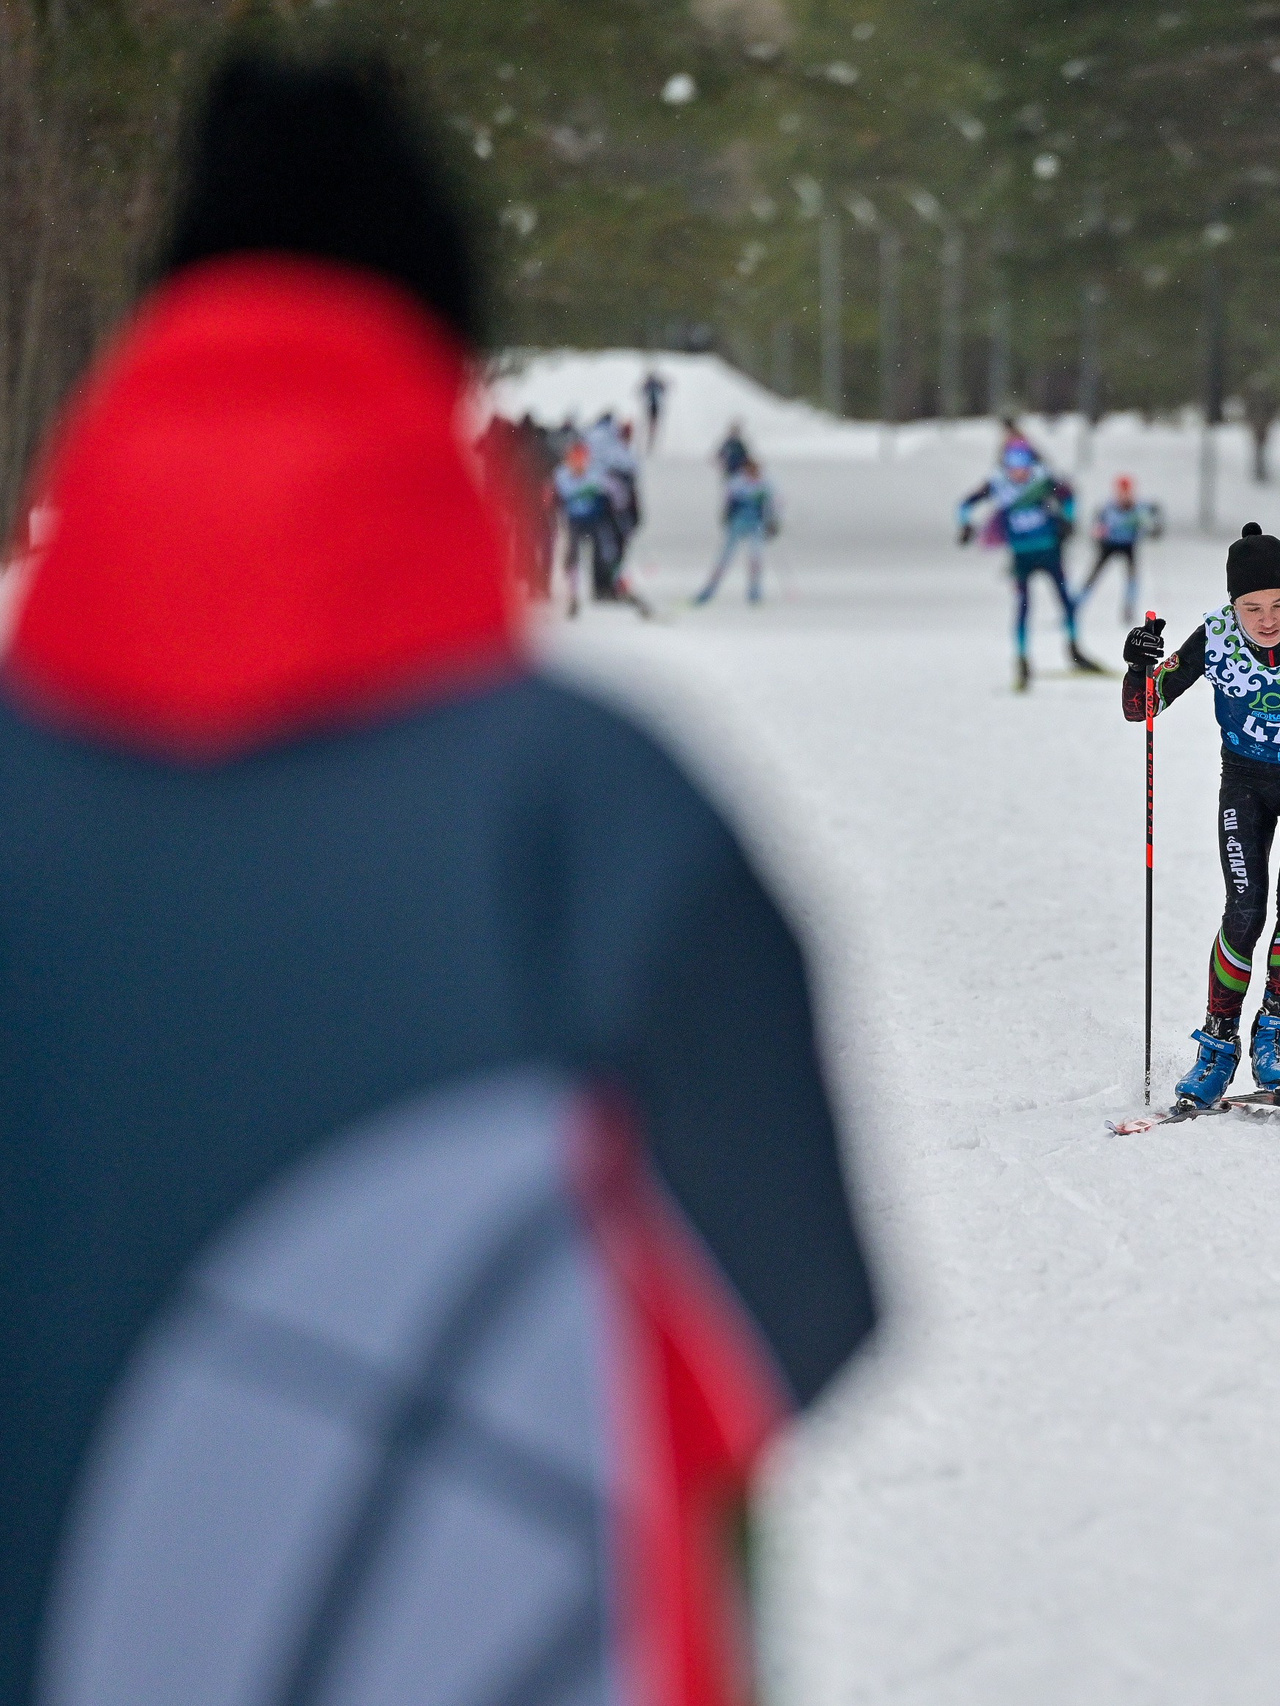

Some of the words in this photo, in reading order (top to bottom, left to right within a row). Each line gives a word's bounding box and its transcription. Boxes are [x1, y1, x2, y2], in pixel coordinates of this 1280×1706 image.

[1223, 808, 1239, 831] СШ
[1226, 835, 1249, 894] «СТАРТ»
[1199, 1035, 1226, 1051] SPINE
